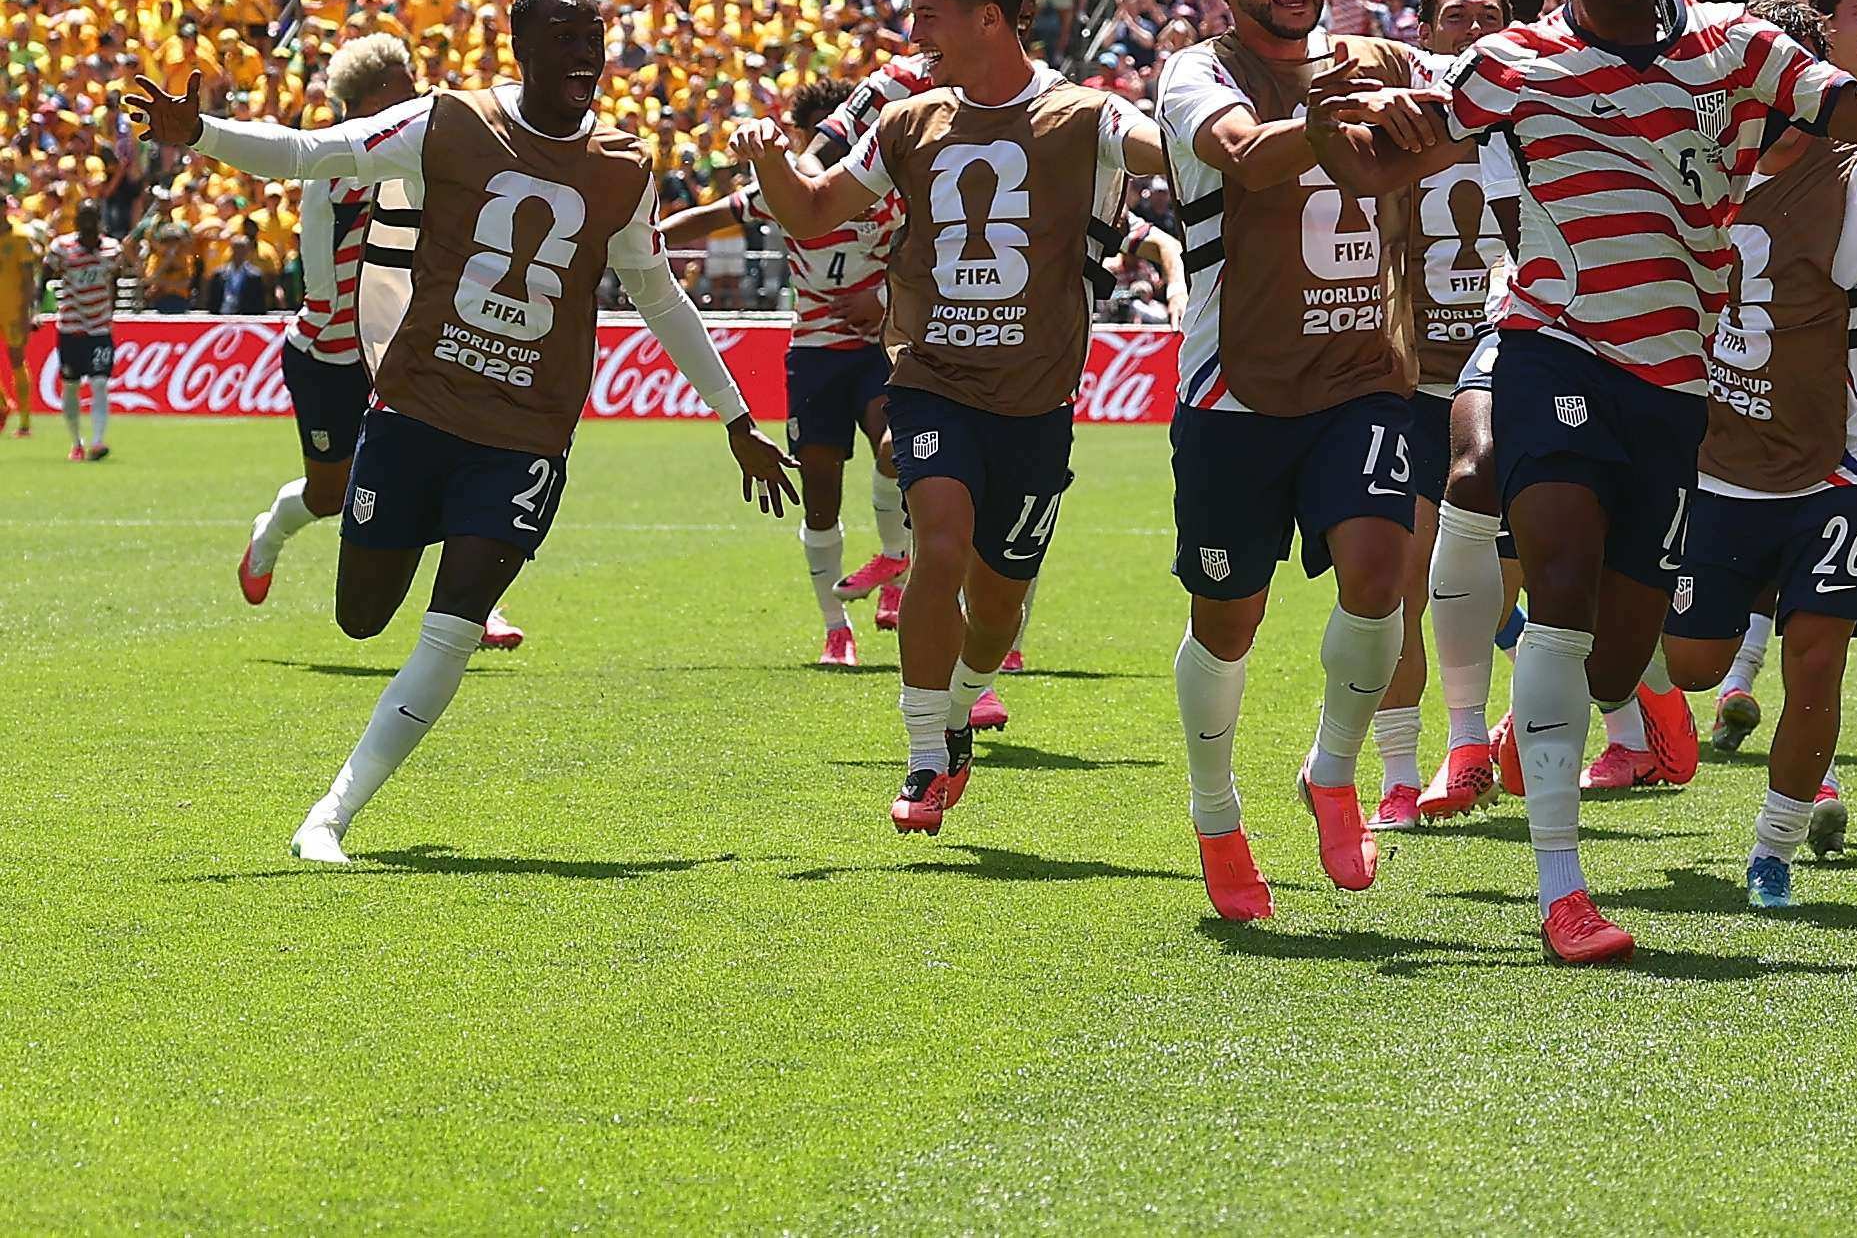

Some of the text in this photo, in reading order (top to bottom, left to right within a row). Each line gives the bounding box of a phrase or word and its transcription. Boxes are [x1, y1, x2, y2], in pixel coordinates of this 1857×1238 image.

[1695, 92, 1725, 114] USA
[1334, 241, 1374, 262] FIFA
[827, 251, 847, 286] 4
[955, 267, 1001, 285] FIFA
[1303, 286, 1370, 306] WORLD
[481, 300, 526, 326] FIFA
[932, 304, 1027, 321] WORLD CUP
[1425, 308, 1484, 321] WORLD
[442, 322, 542, 364] WORLD CUP
[924, 321, 1025, 347] 2026
[1427, 322, 1476, 343] 20
[1722, 331, 1747, 355] FIFA
[39, 322, 294, 412] Cca-Cola
[434, 339, 535, 388] 2026
[1710, 362, 1773, 395] ORLD CUP
[1556, 397, 1584, 410] USA
[1708, 379, 1773, 421] 026
[914, 433, 937, 446] USA
[1362, 424, 1411, 483] 15
[356, 488, 375, 505] USA
[511, 458, 558, 520] 21
[1005, 492, 1061, 547] 14
[1202, 548, 1226, 562] USA
